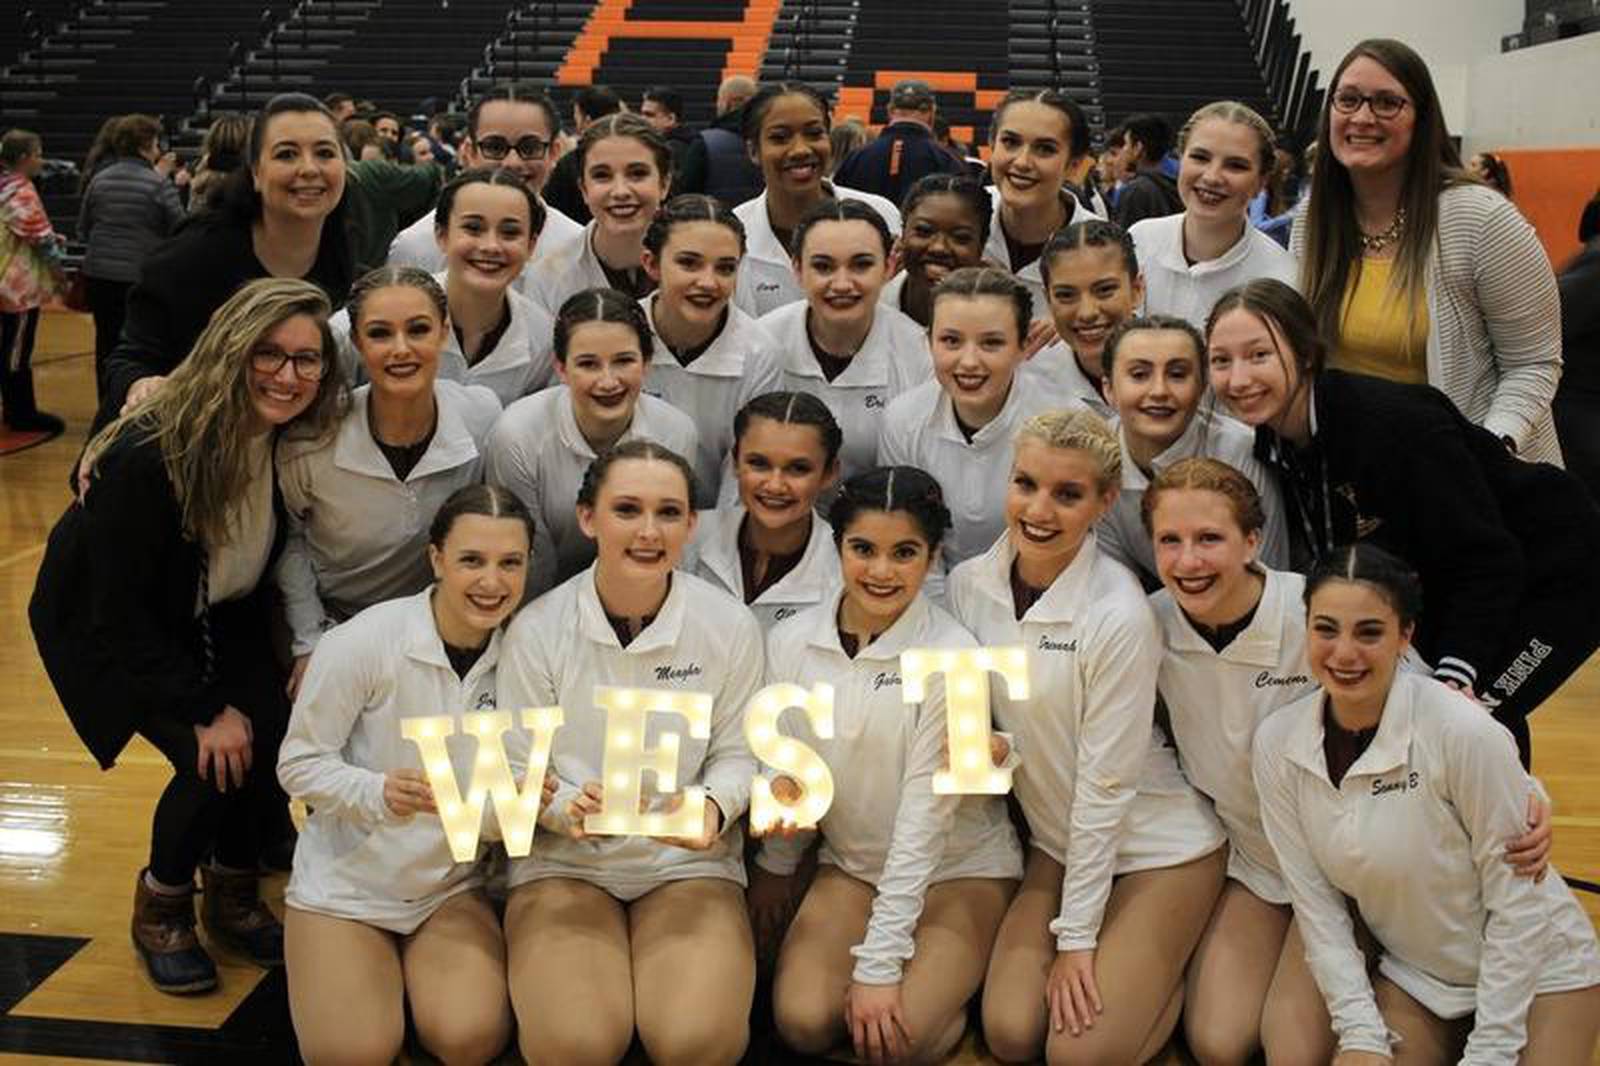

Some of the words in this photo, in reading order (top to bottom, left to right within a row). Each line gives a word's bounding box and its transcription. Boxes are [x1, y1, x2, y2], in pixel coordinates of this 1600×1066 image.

[1493, 637, 1553, 696] PINK
[401, 646, 1031, 863] WEST
[1408, 770, 1419, 789] B
